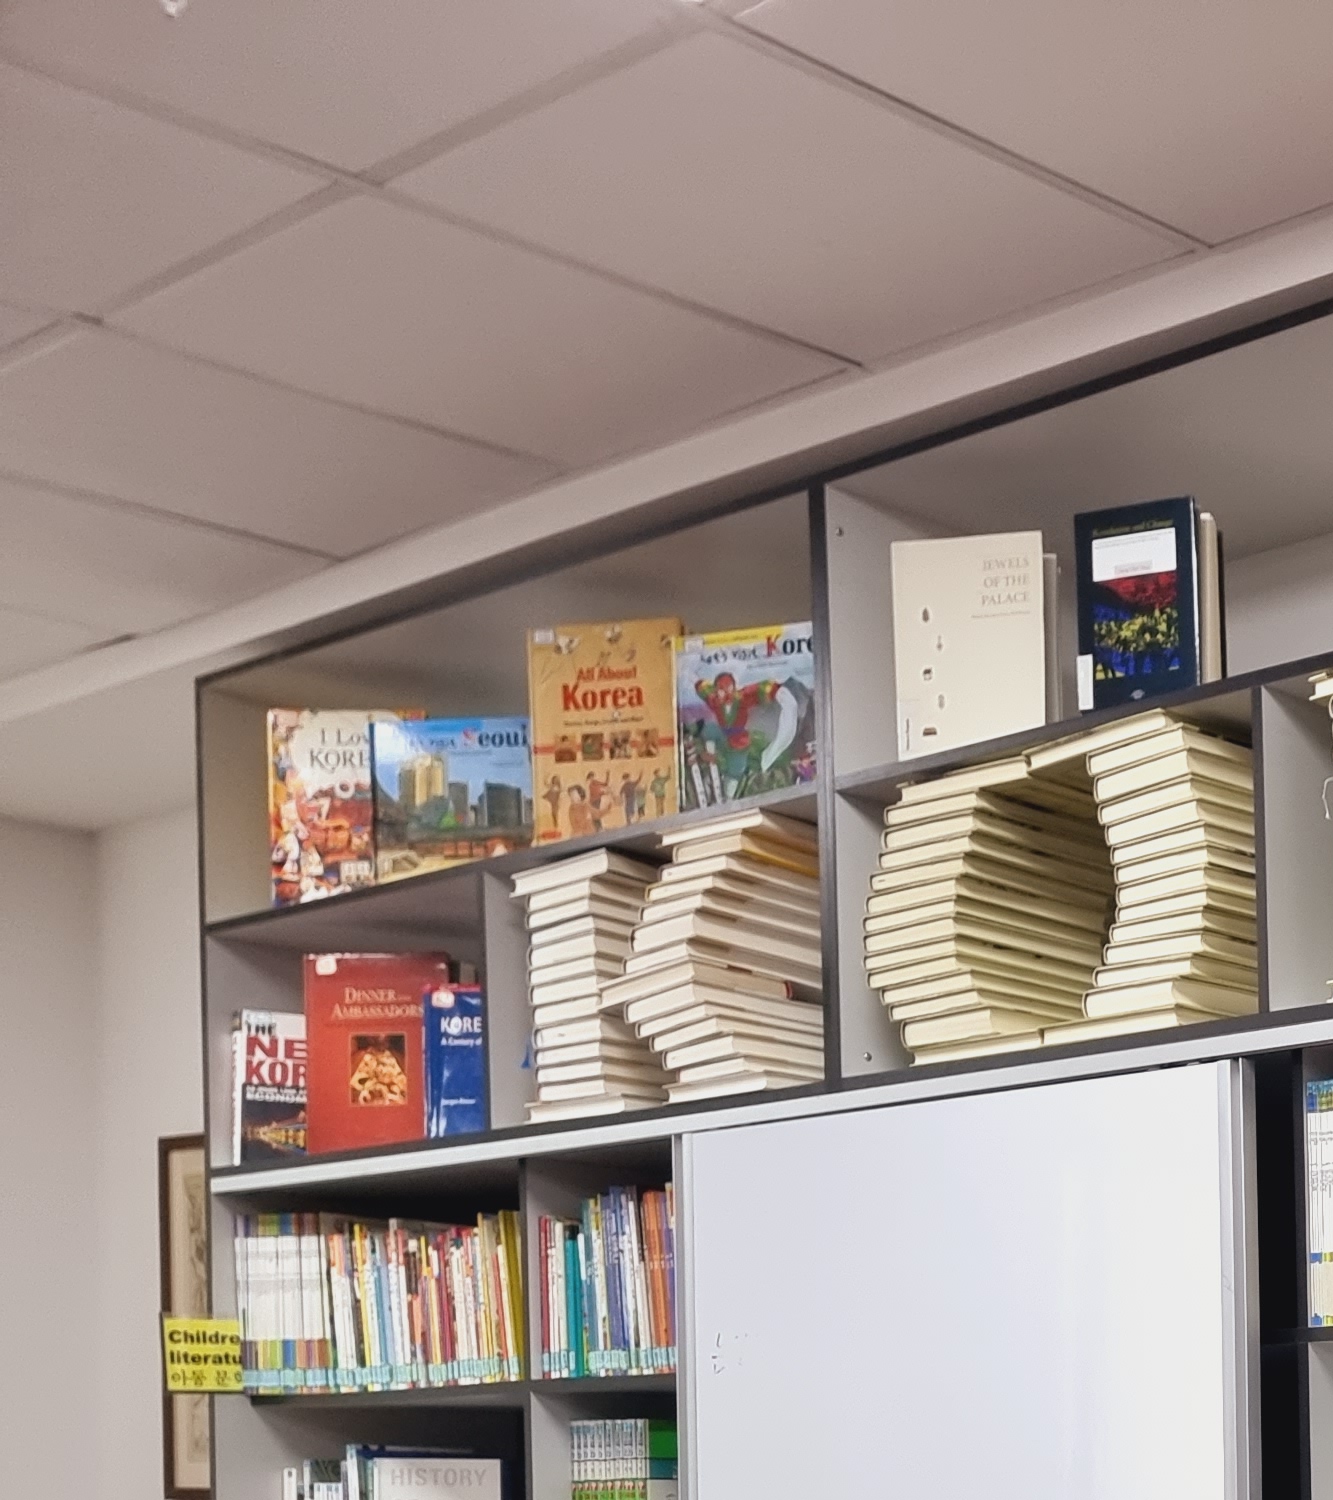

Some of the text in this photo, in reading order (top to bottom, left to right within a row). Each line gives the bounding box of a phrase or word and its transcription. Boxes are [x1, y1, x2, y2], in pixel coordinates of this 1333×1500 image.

[983, 556, 1030, 572] JEWELS
[983, 574, 1028, 588] OF THE
[981, 590, 1028, 606] PALACE
[577, 665, 638, 682] All About
[561, 683, 645, 712] Korea
[462, 724, 530, 749] Seoul
[390, 1467, 488, 1487] HISTORY
